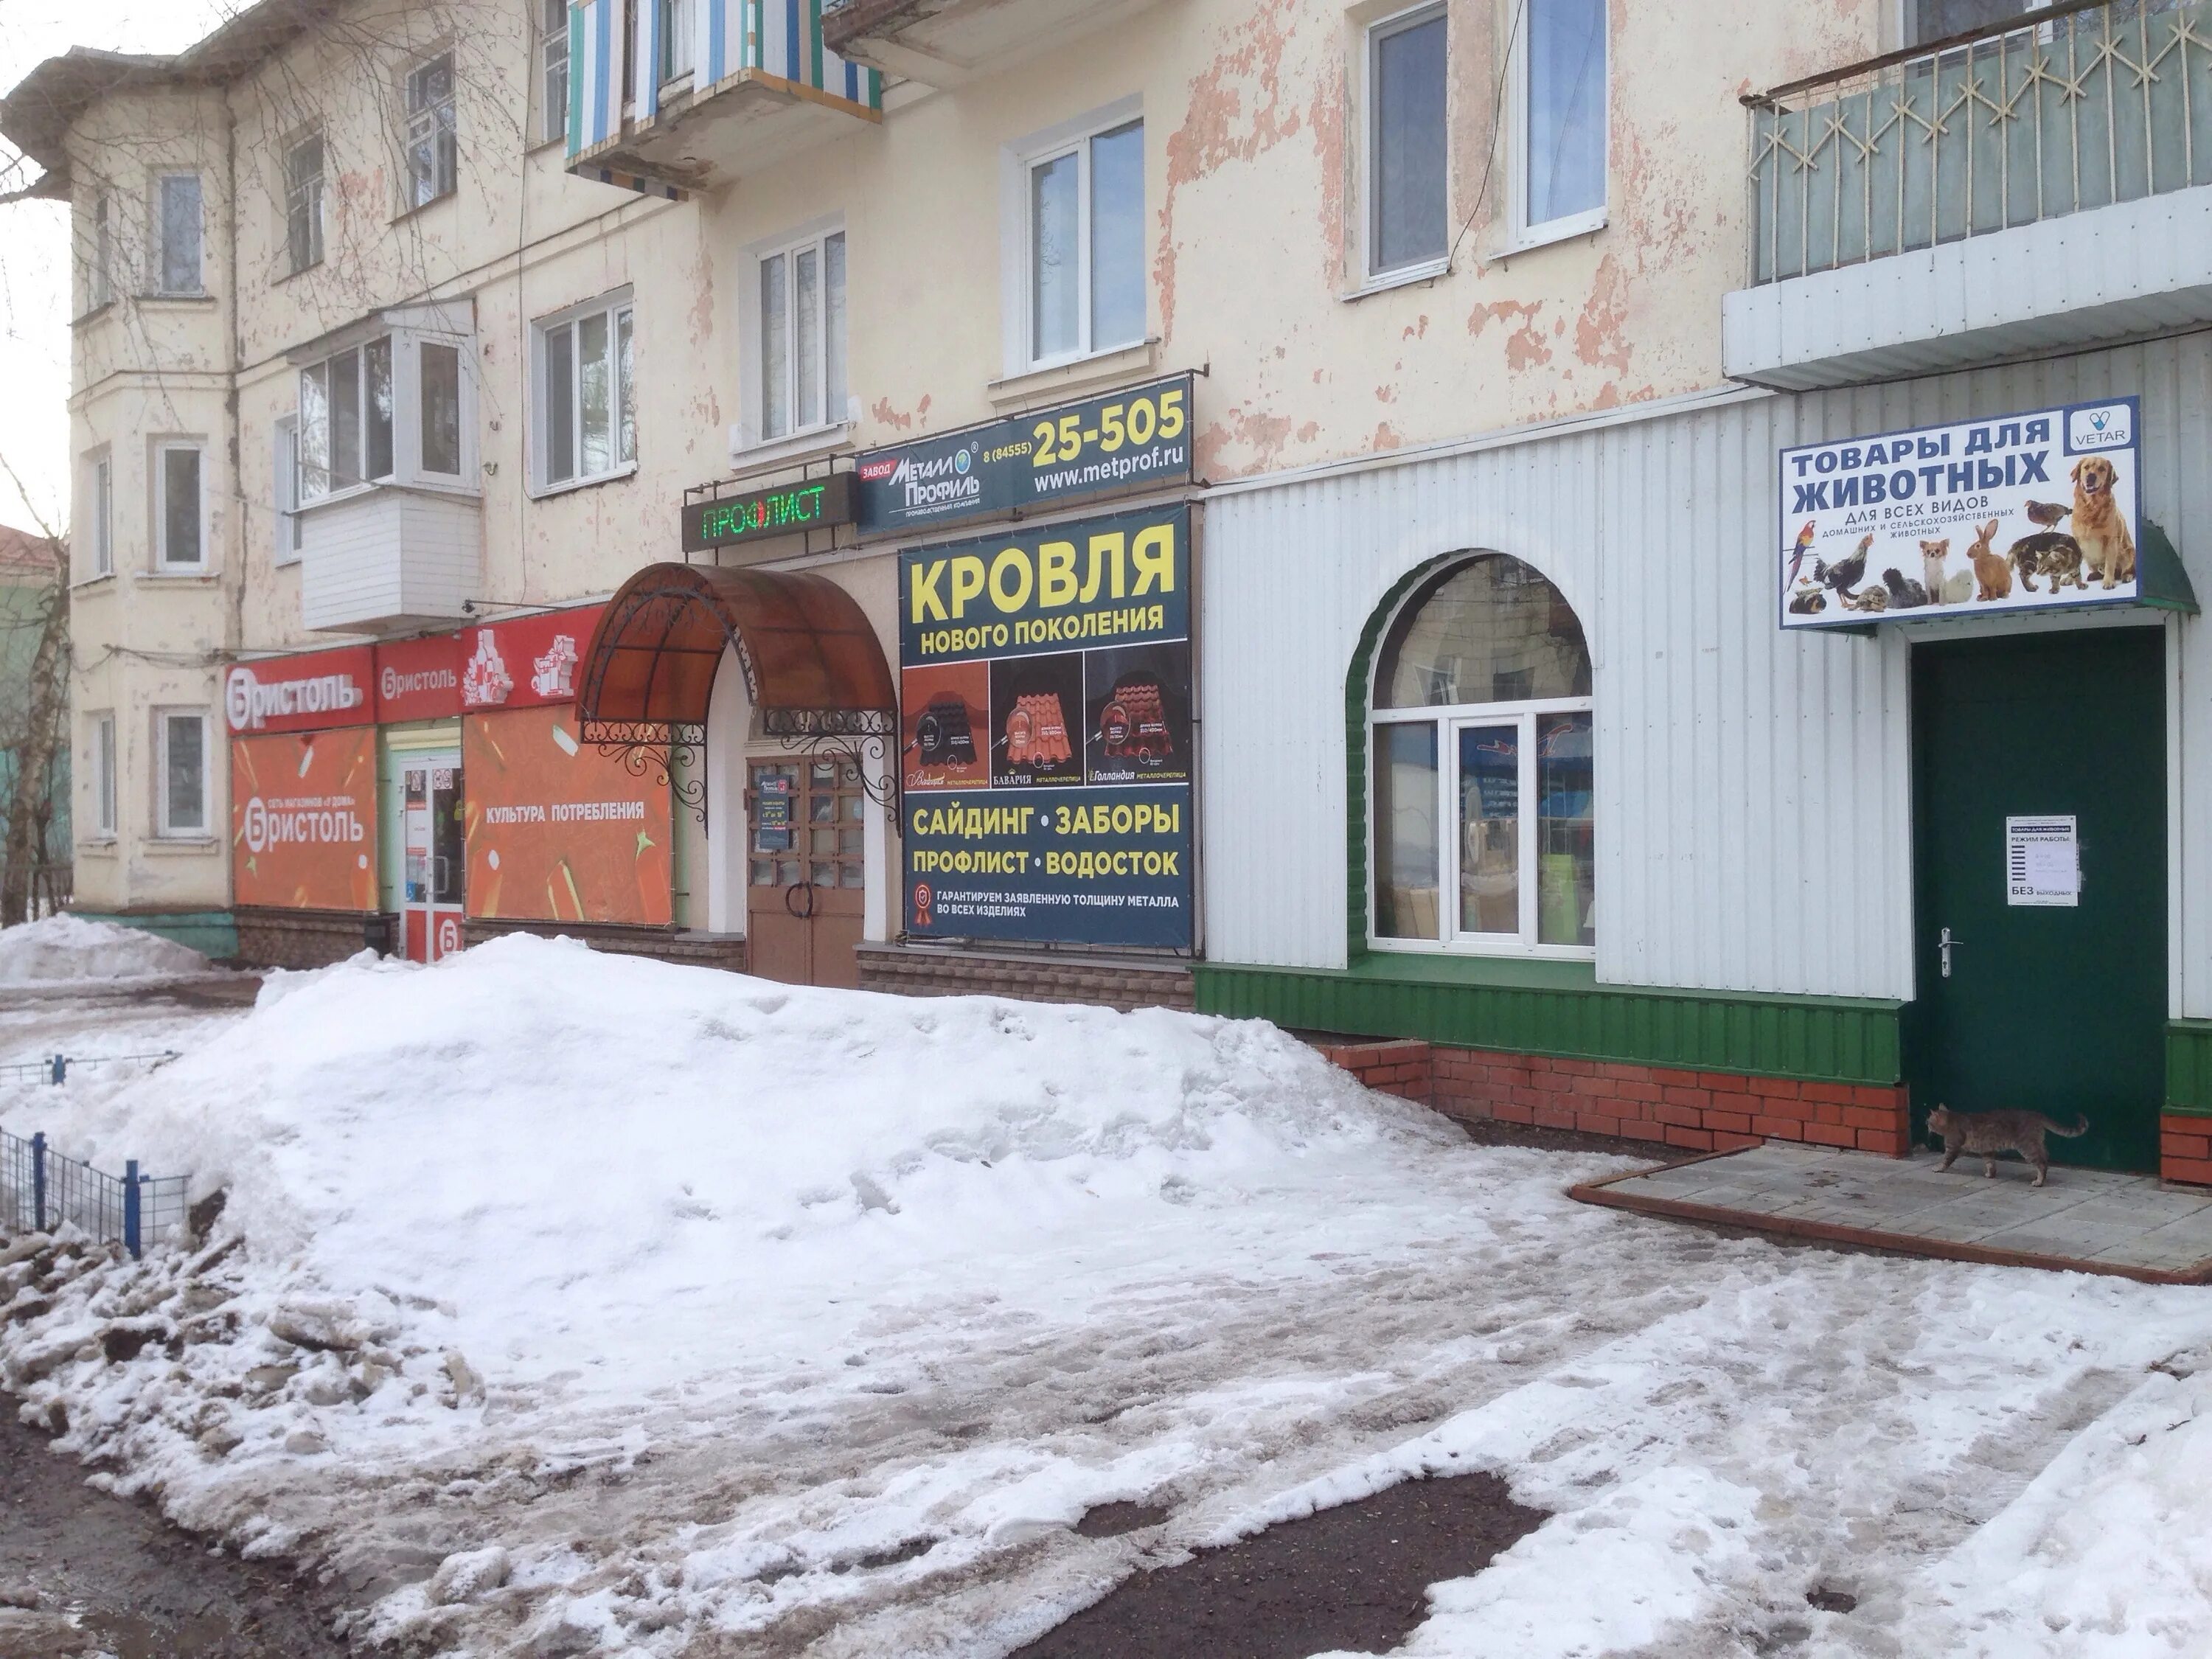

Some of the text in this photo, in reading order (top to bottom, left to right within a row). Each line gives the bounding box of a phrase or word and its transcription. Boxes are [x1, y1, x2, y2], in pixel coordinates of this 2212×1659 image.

[1033, 389, 1185, 467] 25-505
[2075, 429, 2125, 445] VETAR
[984, 442, 1032, 463] 8 (84555)
[1792, 418, 2050, 477] ТОВАРЫ ДЛЯ
[863, 463, 891, 479] ЗАВОД
[1034, 445, 1183, 493] www.metprof.ru
[1792, 449, 2050, 514] ЖИВОТНЫХ
[703, 485, 825, 539] ПРОФЛИСТ
[1822, 525, 1876, 538] ДОМАШНИХ
[1890, 509, 2014, 529] СЕЛЬСКОХОЗЯЙСТВЕННЫХ
[1845, 495, 1989, 526] ДЛЯ ВСЕХ ВИДОВ
[1890, 526, 1941, 539] ЖИВОТНЫХ
[911, 524, 1175, 624] КРОВЛЯ
[921, 605, 1164, 655] НОВОГО ПОКОЛЕНИЯ
[993, 775, 1032, 785] БАВАРИЯ
[1094, 769, 1135, 781] Голландия
[486, 801, 644, 824] КУЛЬТУРА ПОТРЕБЛЕНИЯ
[913, 801, 1180, 839] САЙДИНГ ЗАБОРЫ
[914, 850, 1179, 879] ПРОФЛИСТ ВОДОСТОК
[937, 891, 1180, 908] ГАРАНТИРУЕМ ЗАЯВЛЕННУЮ ТОЛЩИНУ МЕТАЛЛА
[2011, 886, 2034, 895] БЕЗ
[937, 904, 1026, 917] ВО ВСЕХ ИЗДЕЛИЯХ
